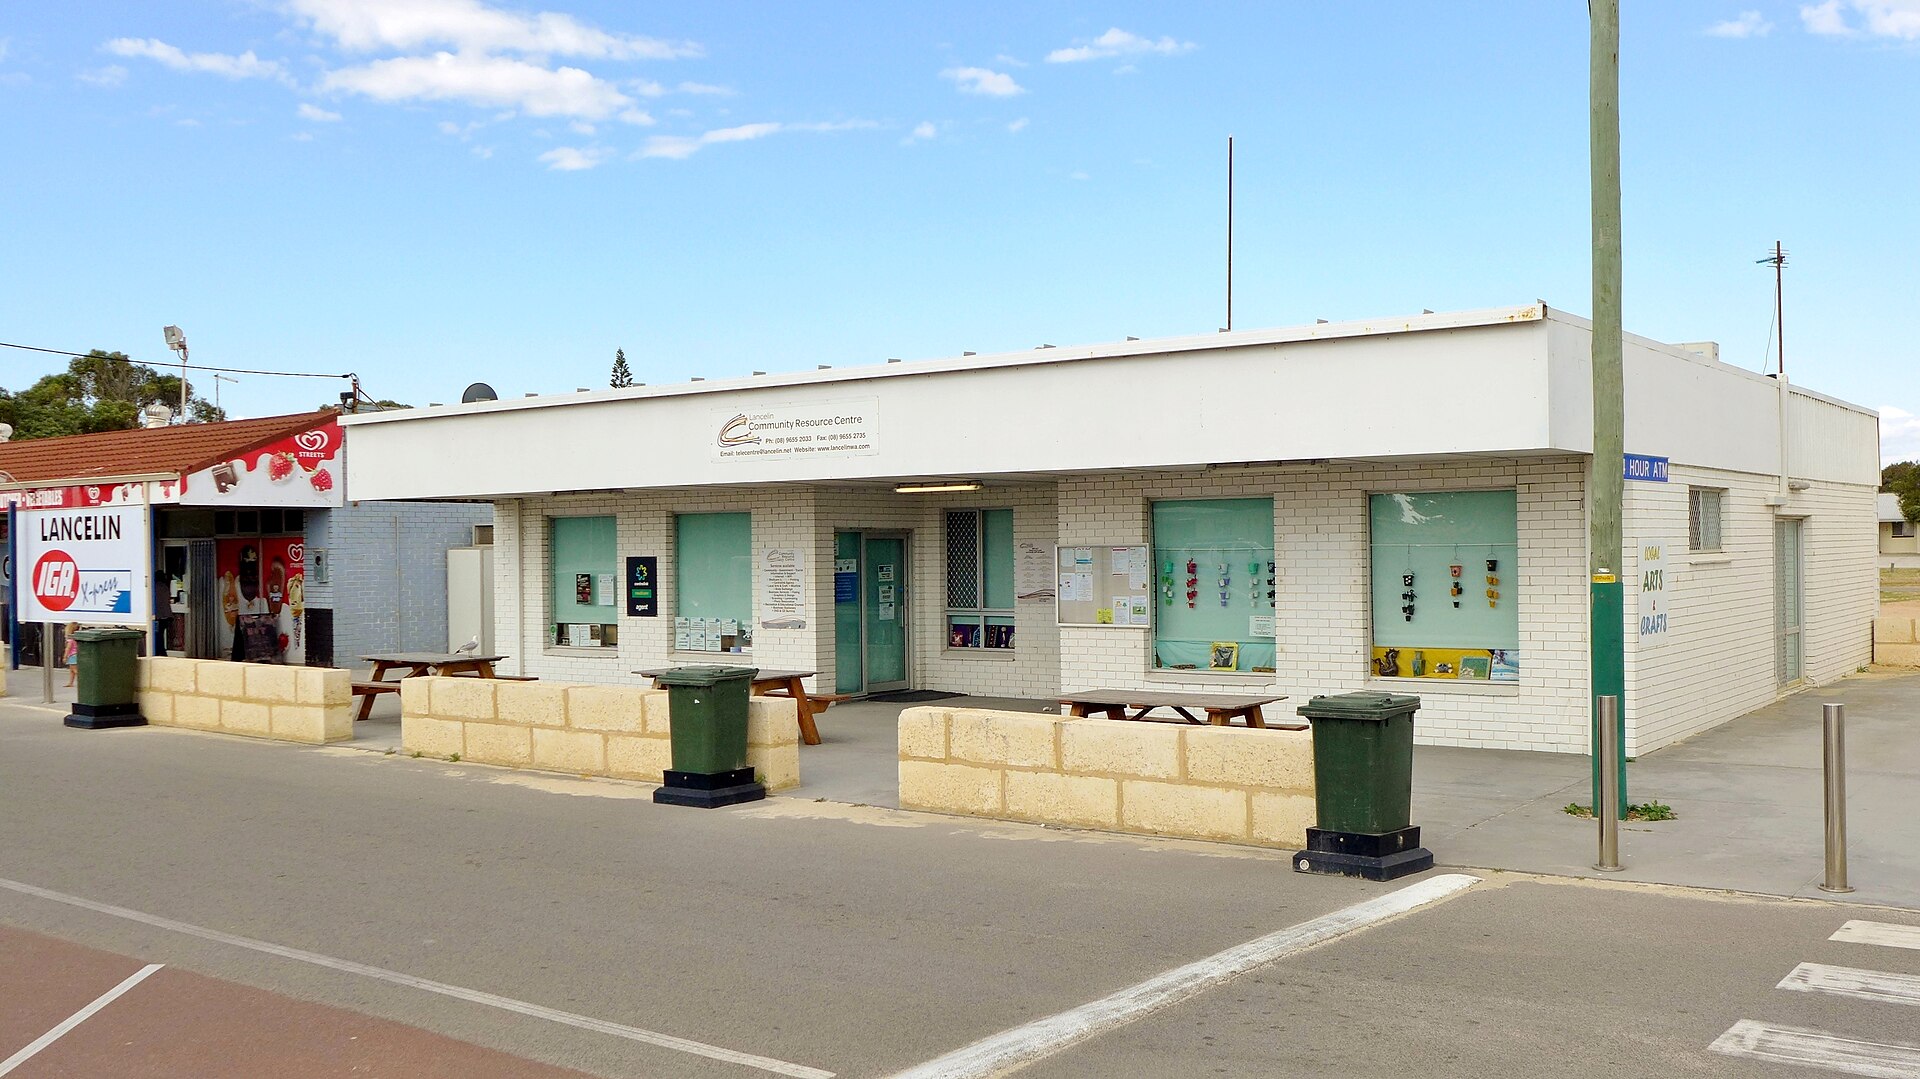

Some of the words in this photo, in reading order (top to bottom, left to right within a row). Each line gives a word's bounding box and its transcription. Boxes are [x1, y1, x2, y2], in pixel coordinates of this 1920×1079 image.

[748, 420, 794, 431] Community
[795, 418, 833, 428] Resource
[834, 416, 863, 426] Centre
[749, 413, 774, 421] Lancelin
[775, 437, 785, 445] (08)
[735, 447, 792, 456] telecentre@lancelin.net
[1629, 459, 1650, 477] HOUR
[1652, 461, 1668, 478] ATM
[41, 514, 121, 541] LANCELIN
[37, 562, 75, 597] IGA
[1643, 569, 1663, 592] ARTS
[1640, 613, 1667, 636] CRAFTS
